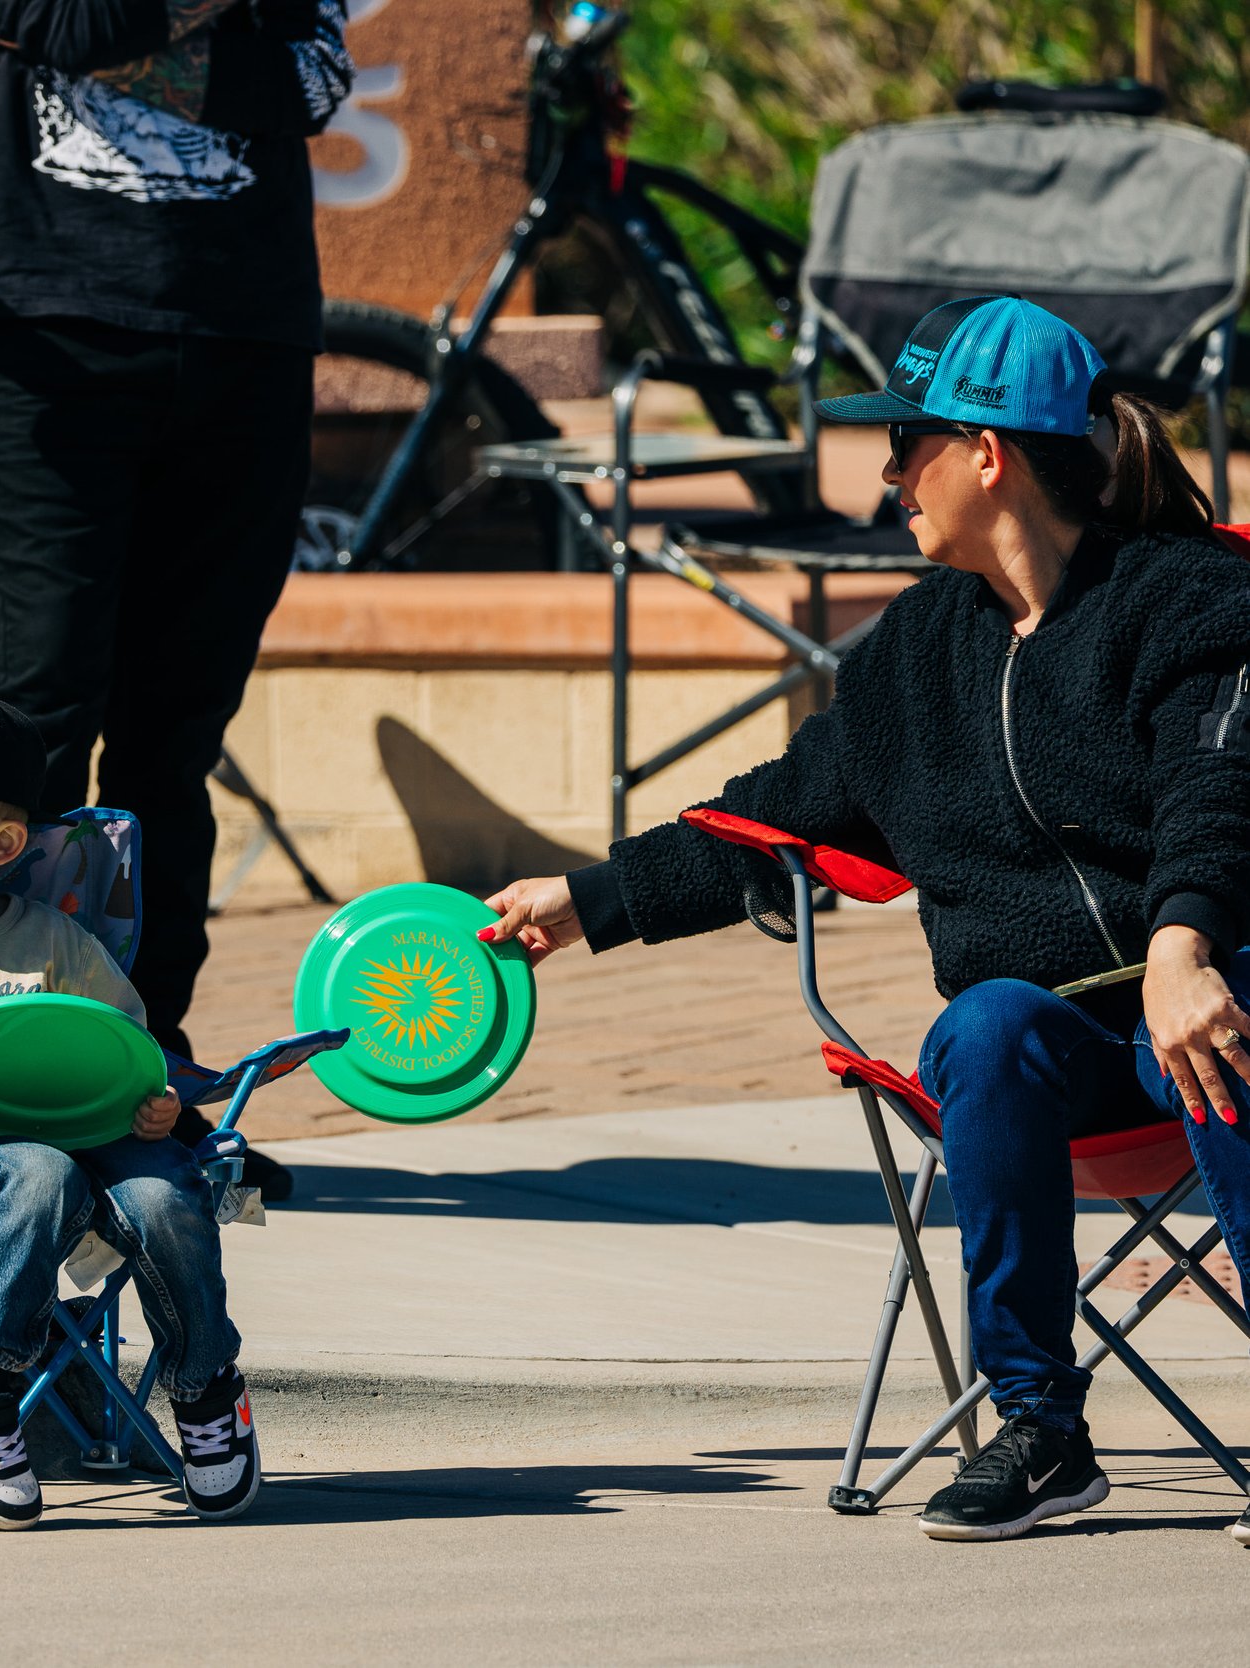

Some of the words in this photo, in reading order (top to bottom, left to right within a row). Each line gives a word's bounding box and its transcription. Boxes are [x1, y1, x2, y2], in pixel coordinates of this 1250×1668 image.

[952, 374, 1007, 403] SUMMIT
[392, 931, 459, 959] MARANA
[459, 955, 484, 1024] UNIFIED
[352, 1026, 415, 1071] DISTRICT
[419, 1025, 477, 1070] SCHOOL
